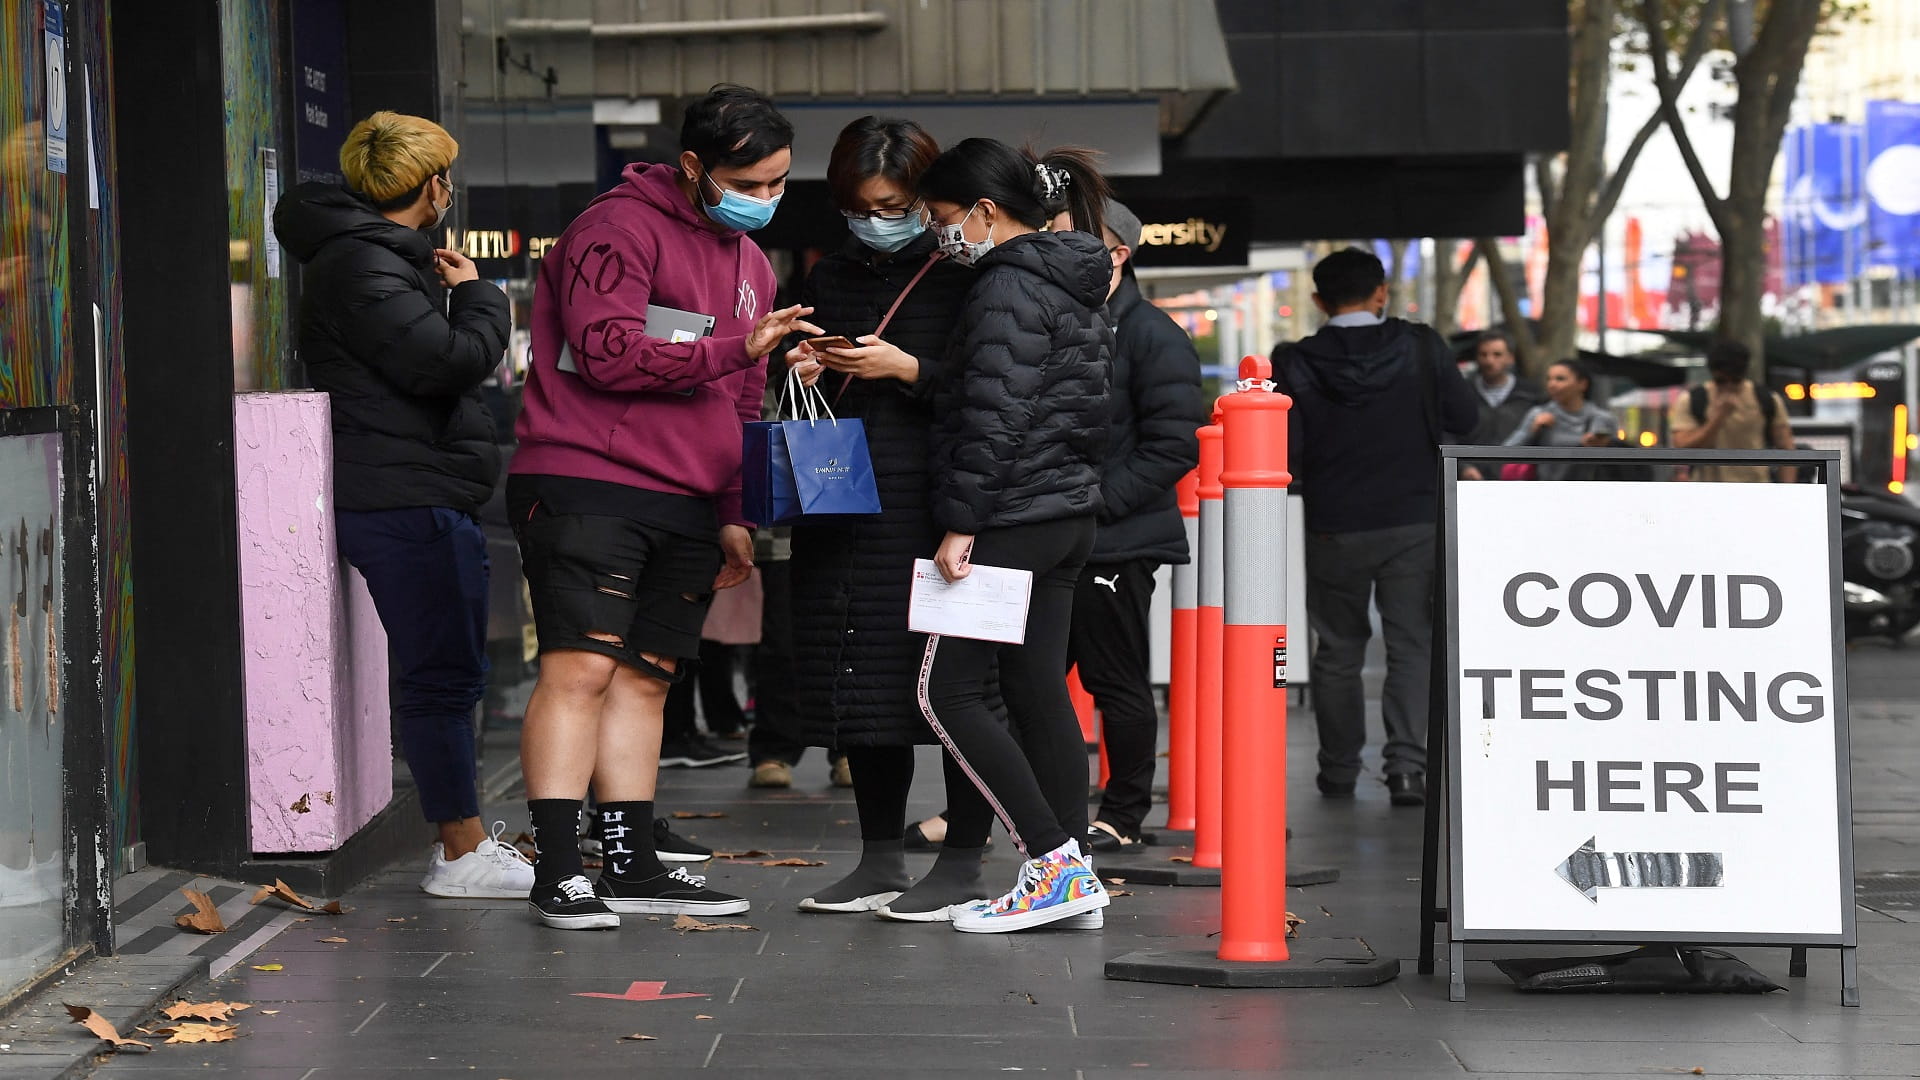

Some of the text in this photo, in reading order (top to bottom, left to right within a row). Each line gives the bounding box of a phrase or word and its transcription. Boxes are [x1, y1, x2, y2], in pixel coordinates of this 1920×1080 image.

[1502, 572, 1783, 629] COVID
[1463, 668, 1825, 723] TESTING
[1535, 760, 1763, 813] HERE
